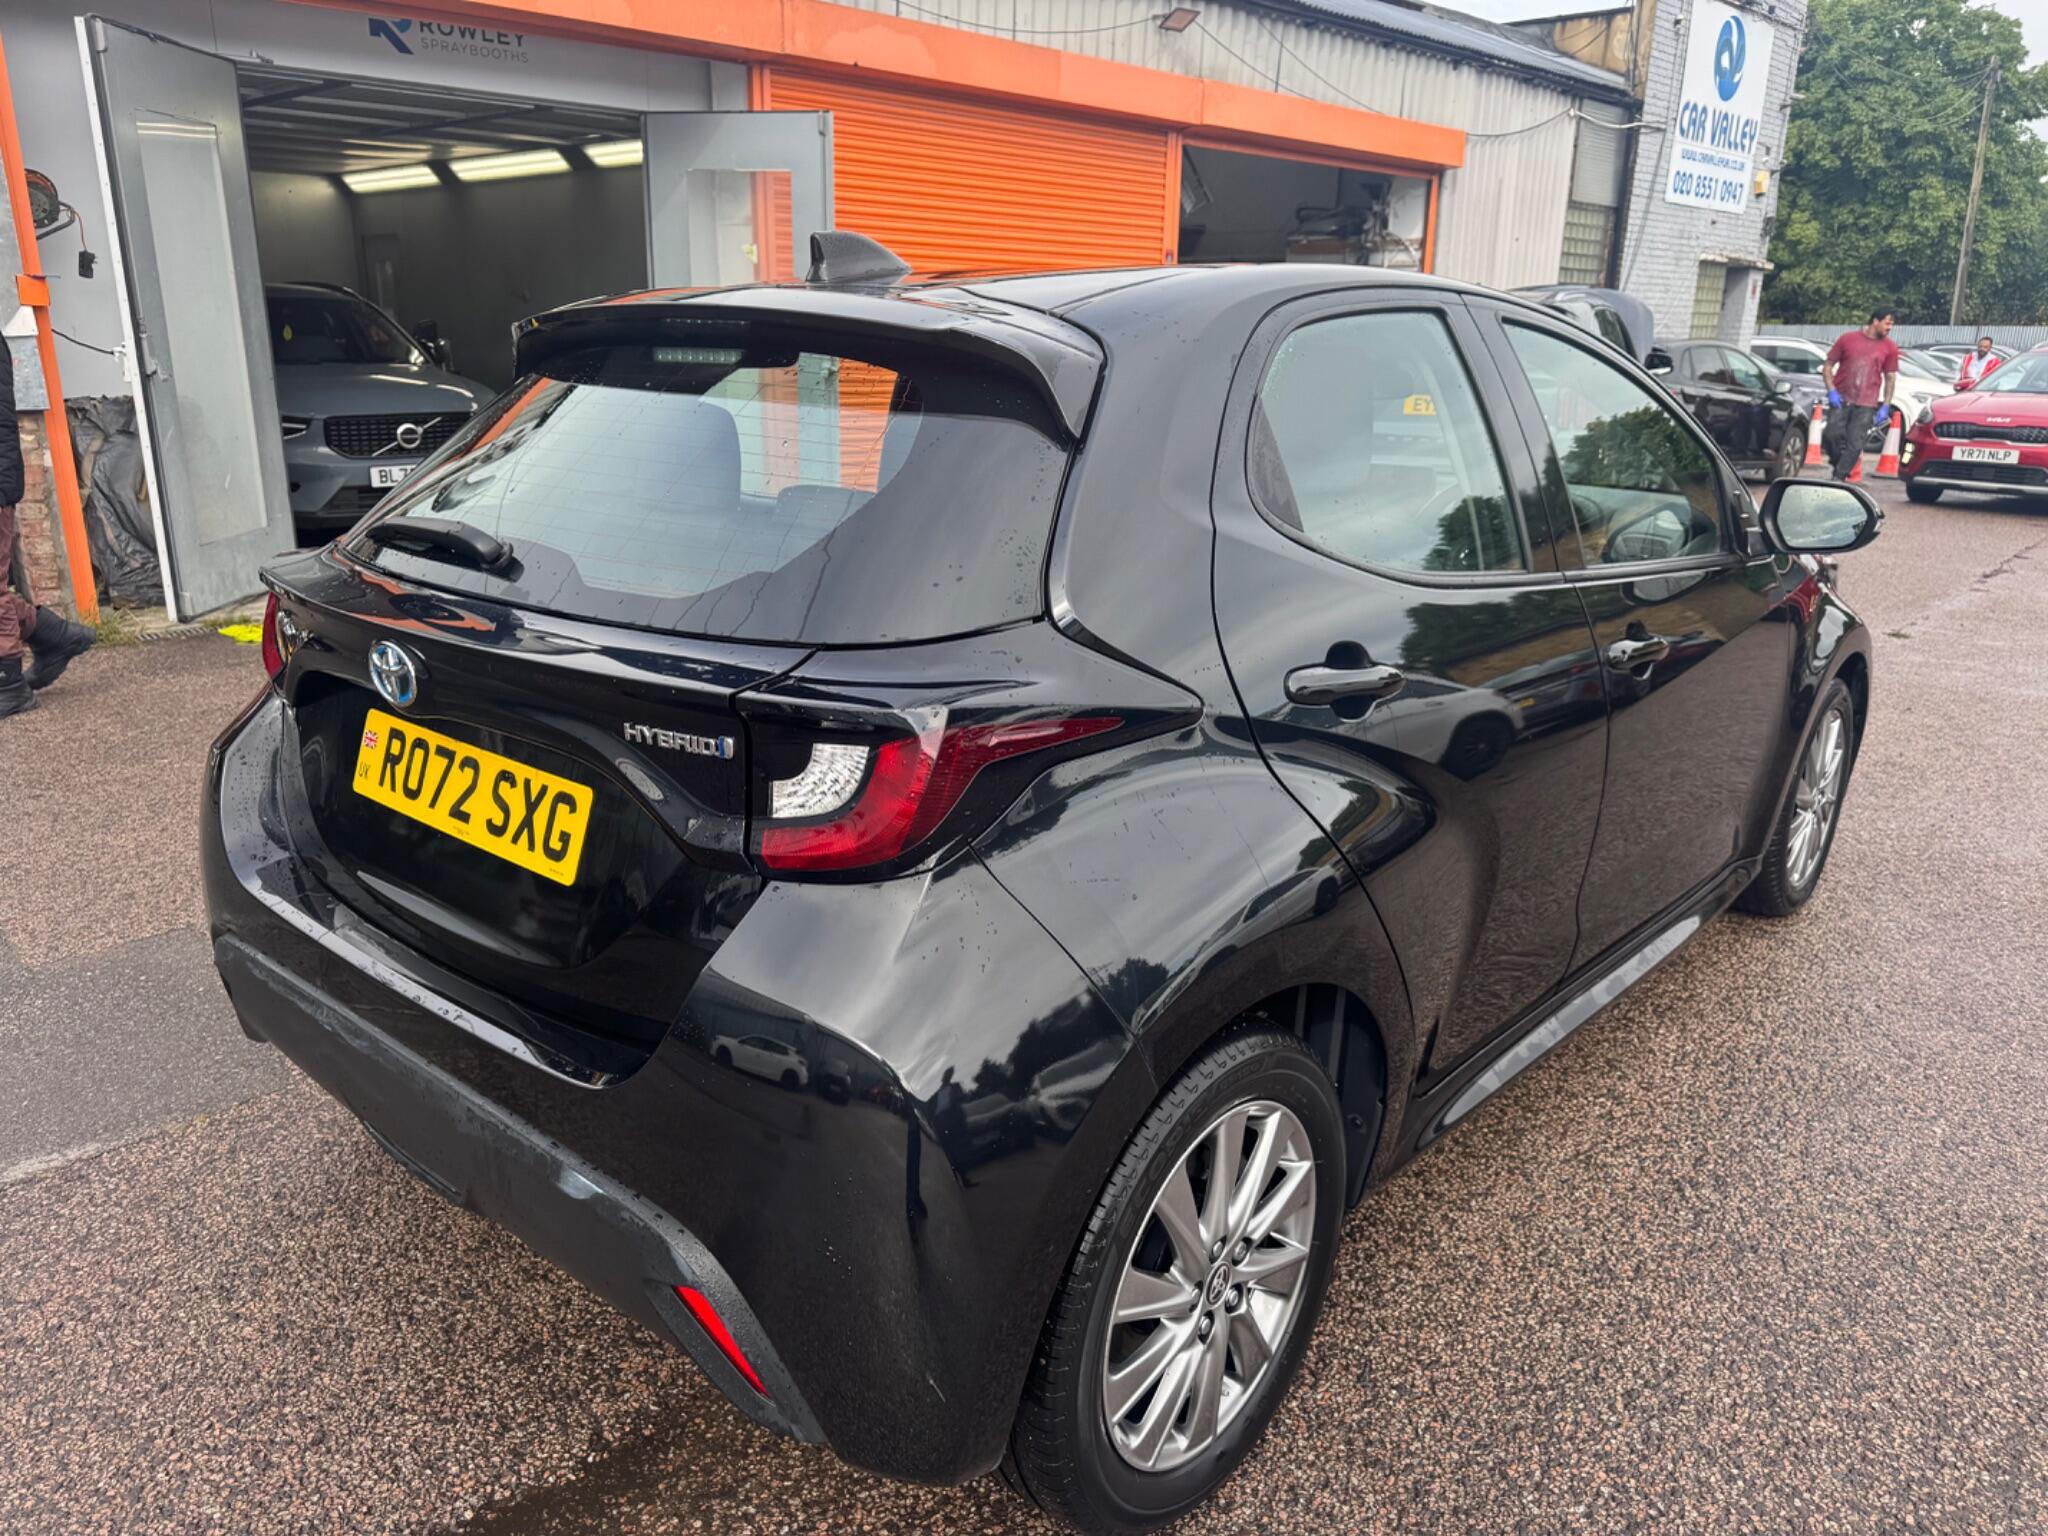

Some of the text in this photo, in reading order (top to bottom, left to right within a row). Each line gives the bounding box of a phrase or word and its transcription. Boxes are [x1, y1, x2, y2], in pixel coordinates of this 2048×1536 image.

[419, 21, 525, 47] ROWLEY
[420, 37, 529, 63] SPRAYBOOTHS
[1679, 101, 1758, 155] CAR VALLEY
[1673, 170, 1744, 205] 020 8551 0947
[1413, 397, 1436, 412] EY
[1960, 447, 2012, 461] YR71 NLP
[379, 468, 417, 484] BL7
[623, 722, 716, 756] HYBRID
[359, 761, 371, 780] UK
[378, 726, 578, 863] RO72 SXG
